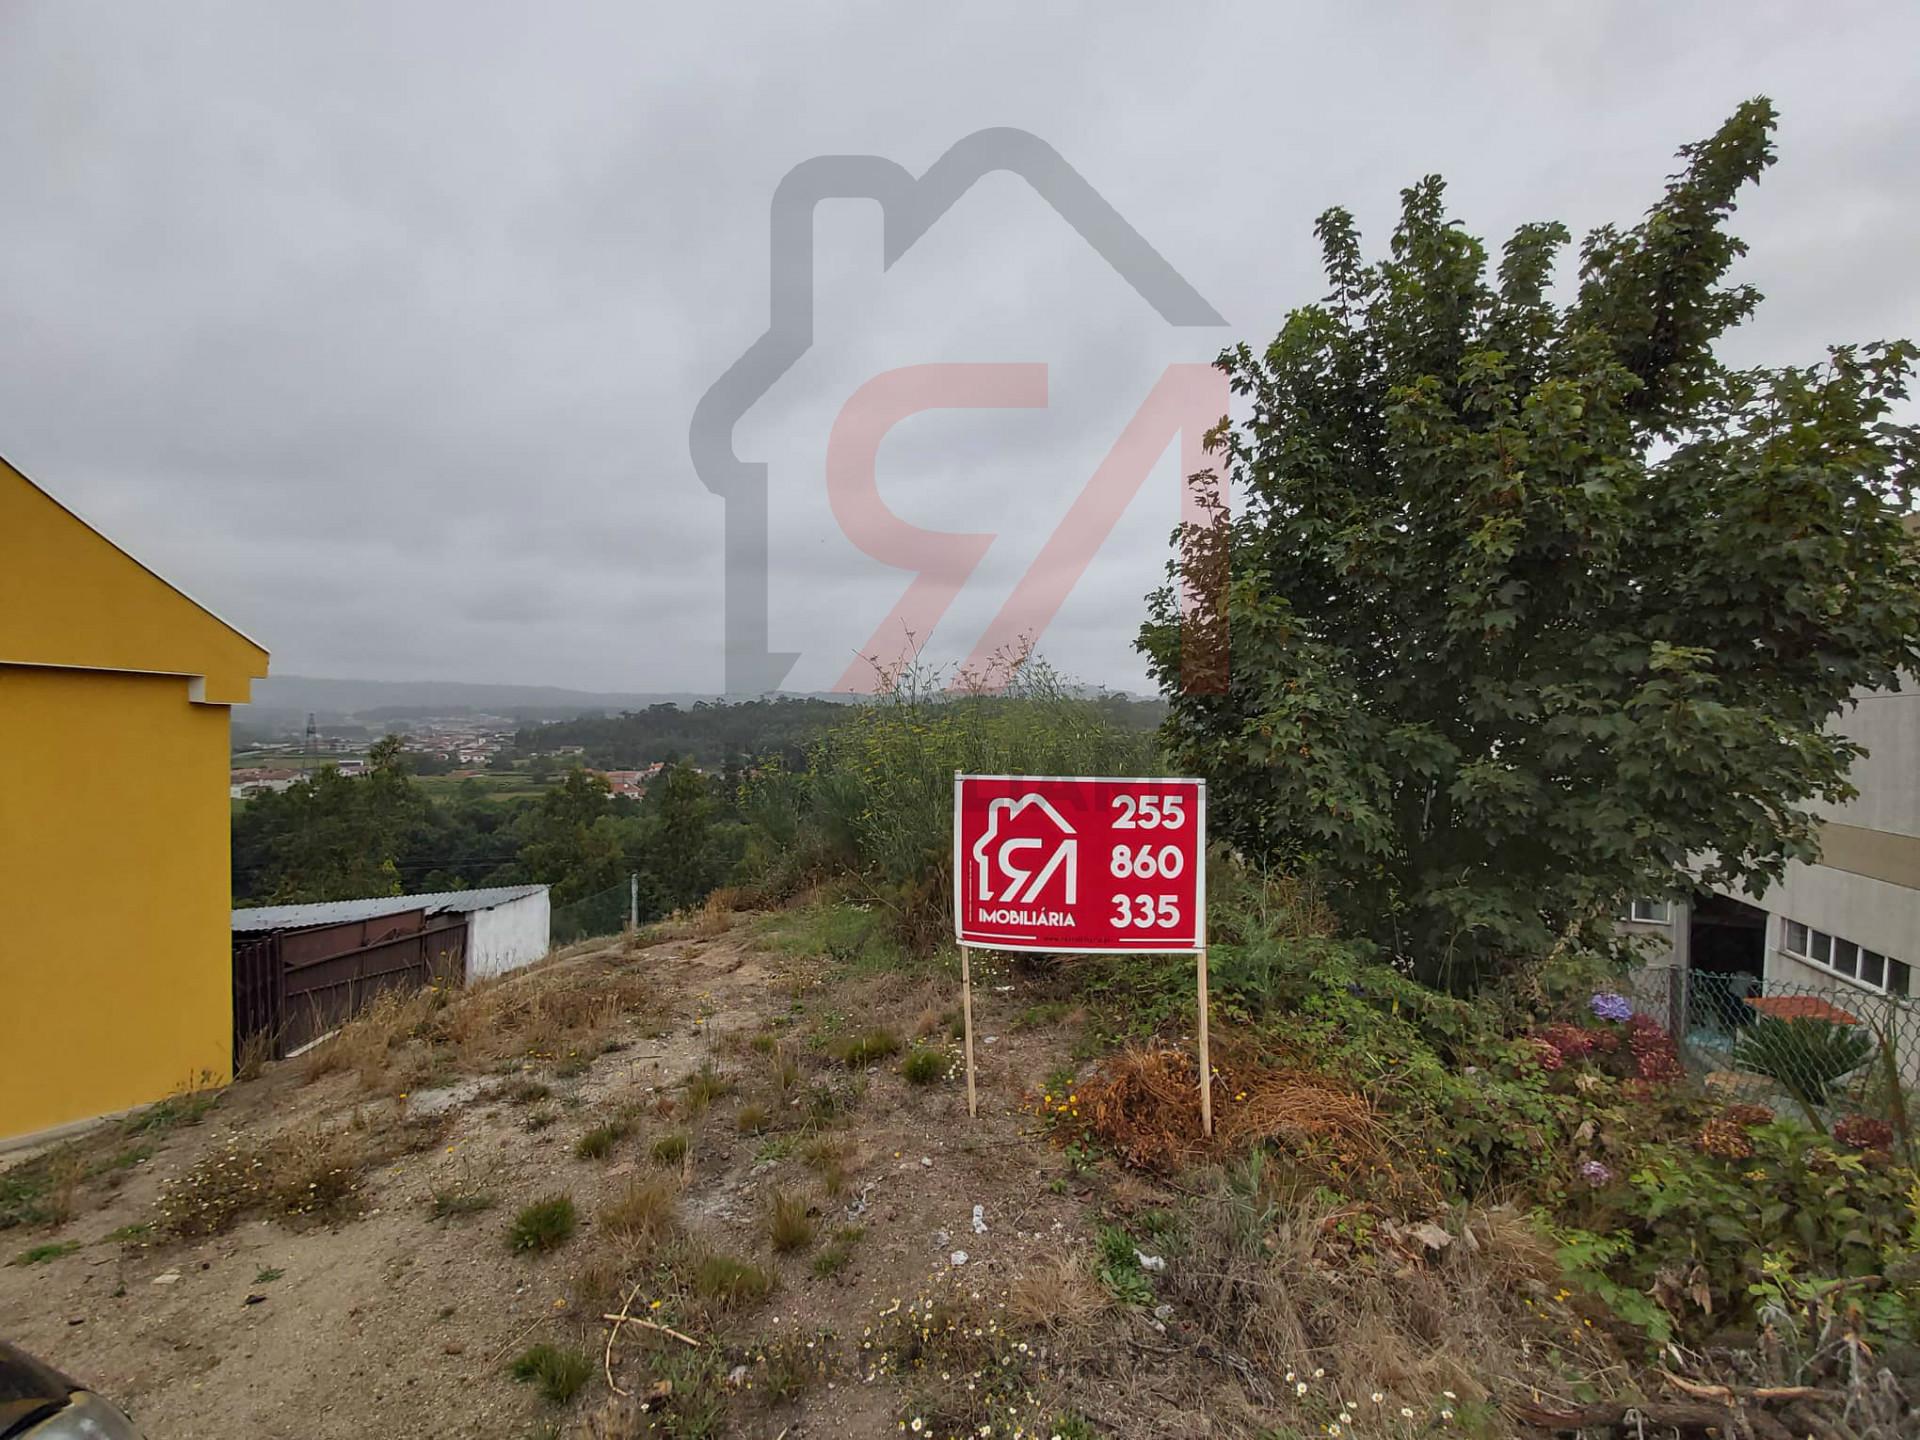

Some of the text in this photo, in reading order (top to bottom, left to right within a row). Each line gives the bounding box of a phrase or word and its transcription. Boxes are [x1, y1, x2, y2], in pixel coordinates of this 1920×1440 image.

[1111, 794, 1186, 830] 255
[1109, 844, 1184, 880] 860
[978, 907, 1076, 927] IMOBILIÁRIA
[1109, 893, 1181, 929] 335
